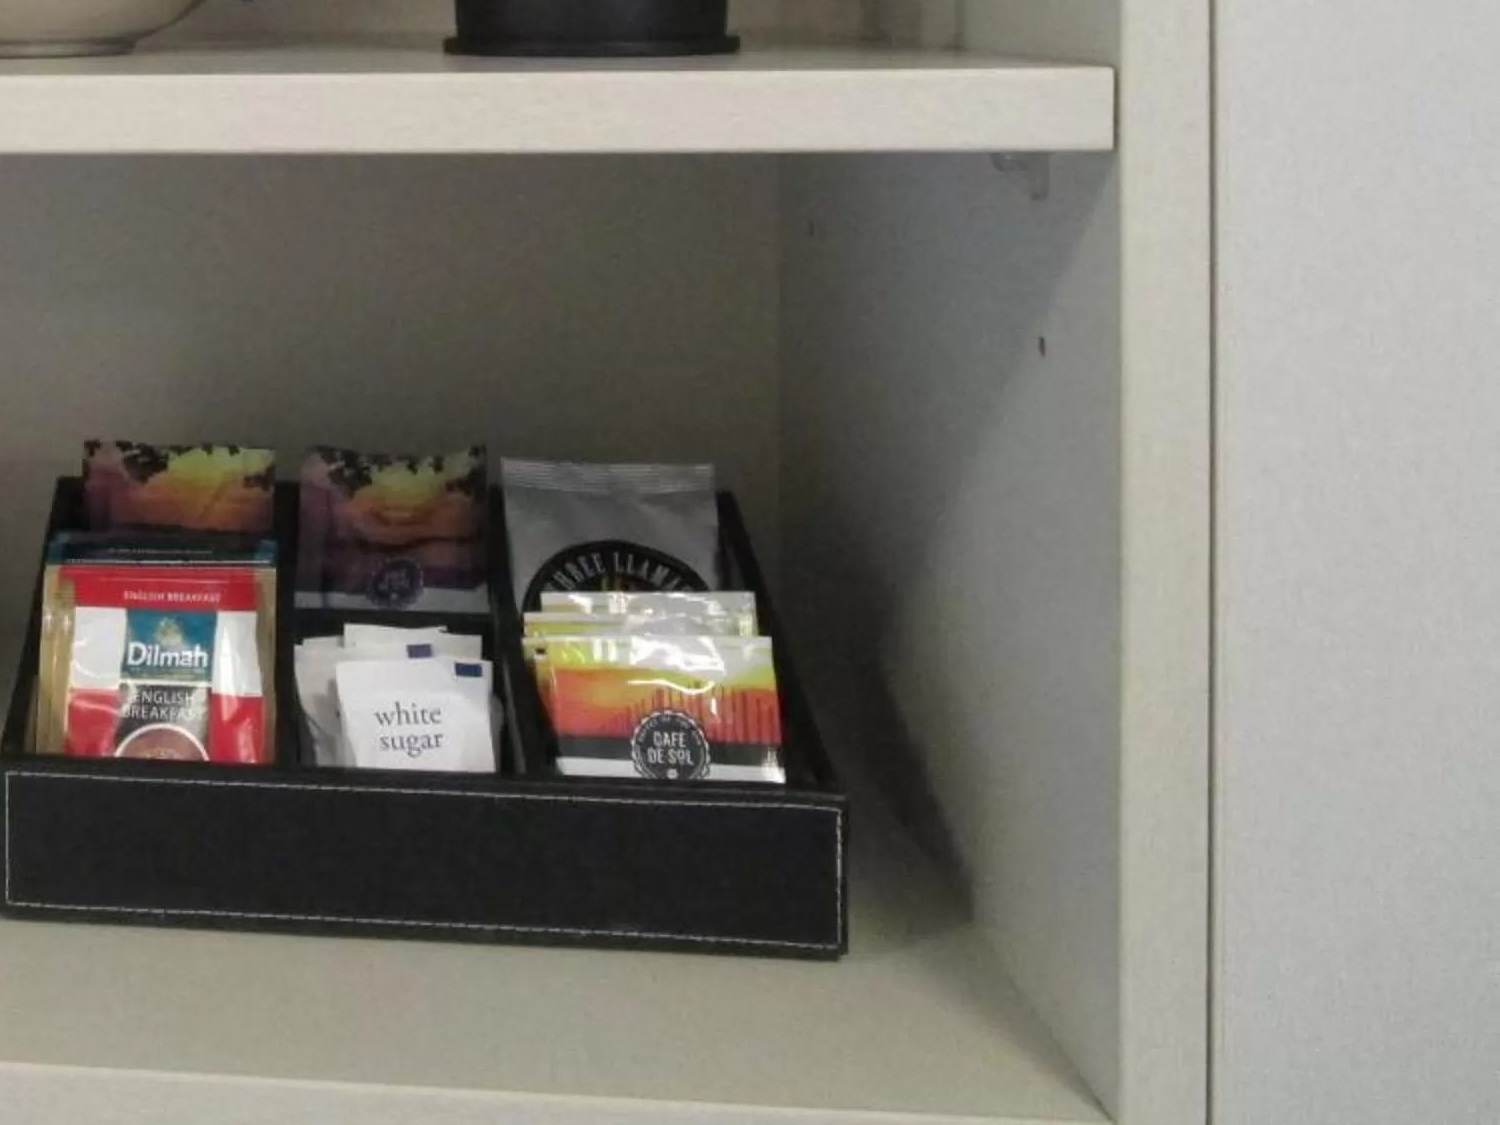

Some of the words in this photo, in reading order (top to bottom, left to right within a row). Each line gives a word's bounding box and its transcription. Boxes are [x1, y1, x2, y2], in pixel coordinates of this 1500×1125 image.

[127, 642, 209, 668] Dilmah
[131, 690, 195, 705] ENGLISH
[373, 701, 442, 725] white
[380, 734, 443, 757] sugar
[647, 747, 664, 764] DE
[667, 748, 694, 766] SOL
